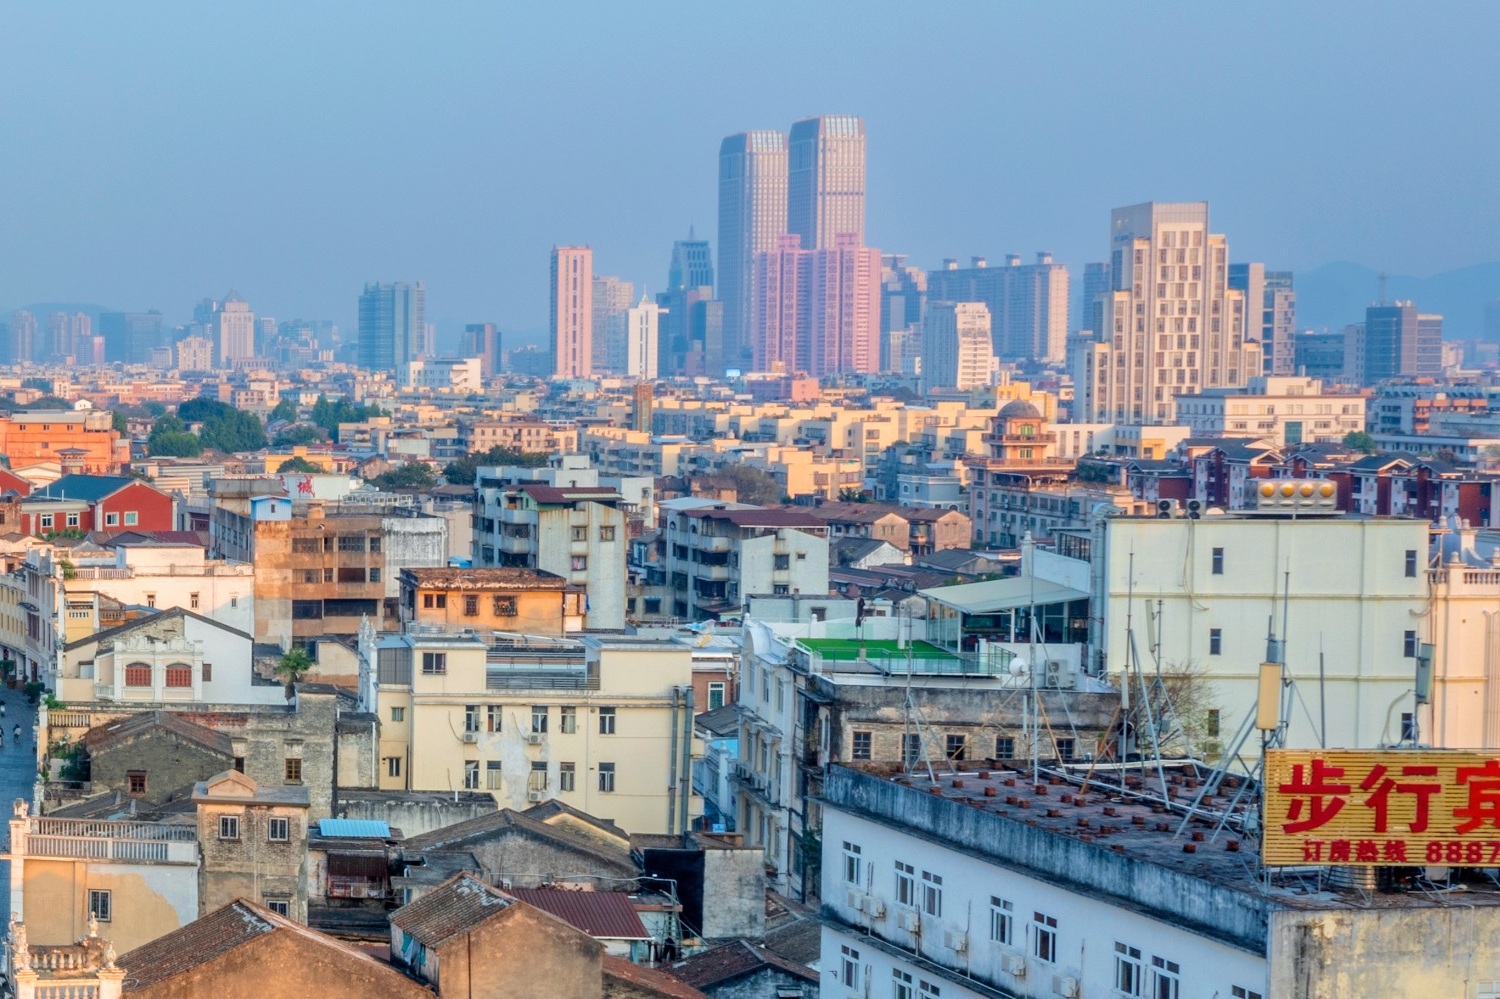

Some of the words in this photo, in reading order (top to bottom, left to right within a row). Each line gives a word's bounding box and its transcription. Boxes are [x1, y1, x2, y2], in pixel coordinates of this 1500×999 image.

[1278, 758, 1500, 835] 步行宾
[1302, 839, 1407, 863] 订房热线
[1425, 840, 1500, 864] 8887
